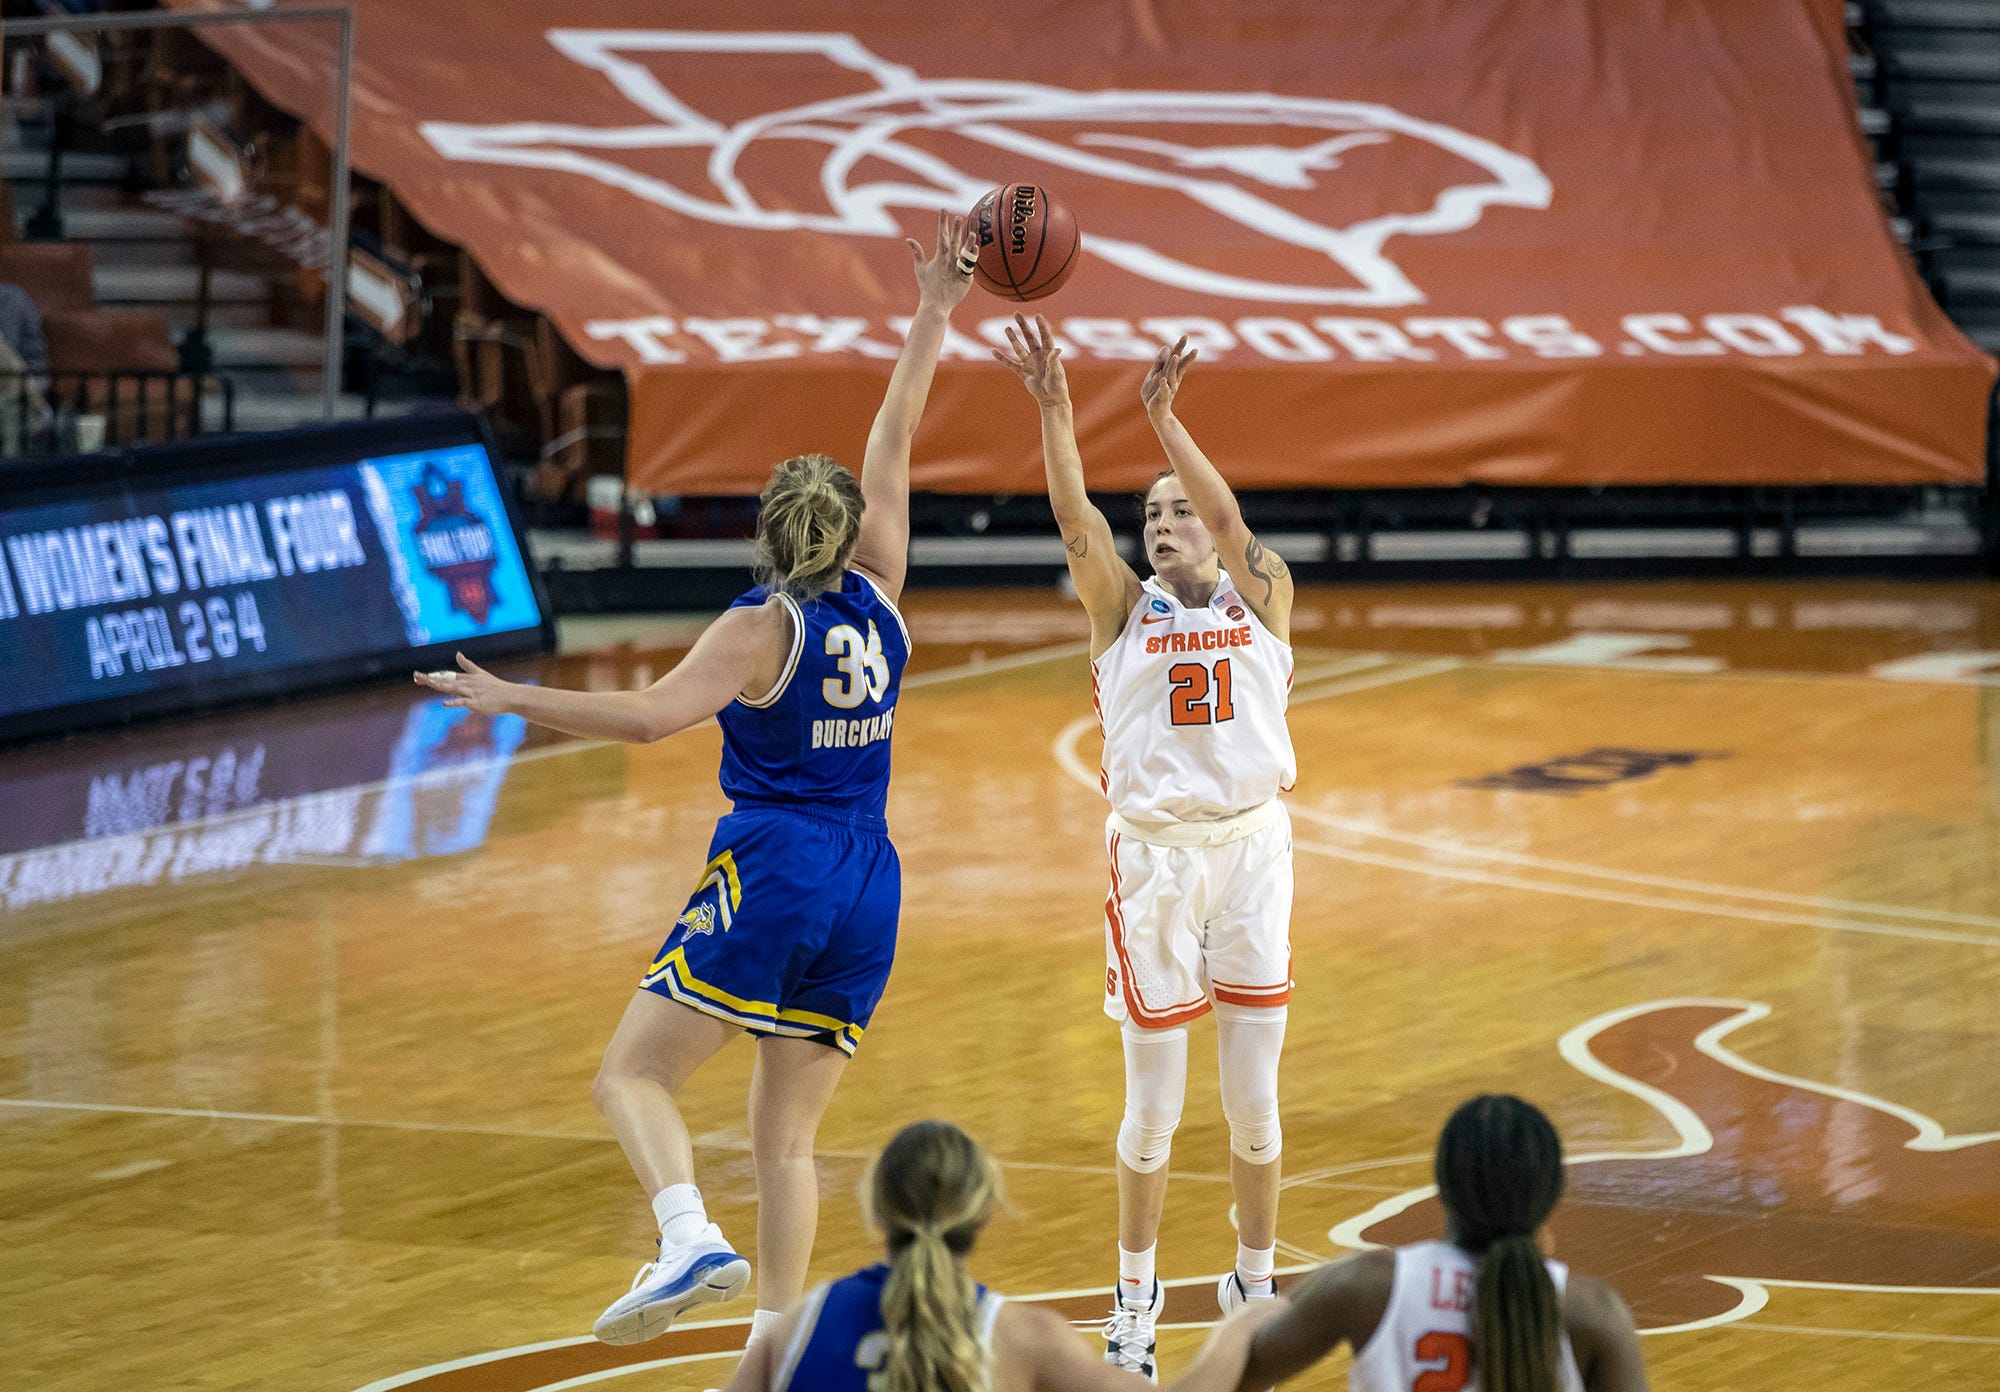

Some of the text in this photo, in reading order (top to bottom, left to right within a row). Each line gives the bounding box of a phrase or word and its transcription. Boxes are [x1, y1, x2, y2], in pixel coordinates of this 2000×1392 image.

[1011, 185, 1036, 256] Wilson
[7, 514, 181, 616] WOMEN'S
[169, 500, 279, 591] FINAL
[263, 488, 367, 577] FOUR
[85, 604, 187, 680] APRIL
[178, 599, 213, 664] 2
[234, 590, 267, 653] 4
[1145, 625, 1253, 654] SYRACUSE
[1168, 657, 1235, 726] 21
[1106, 966, 1118, 997] S
